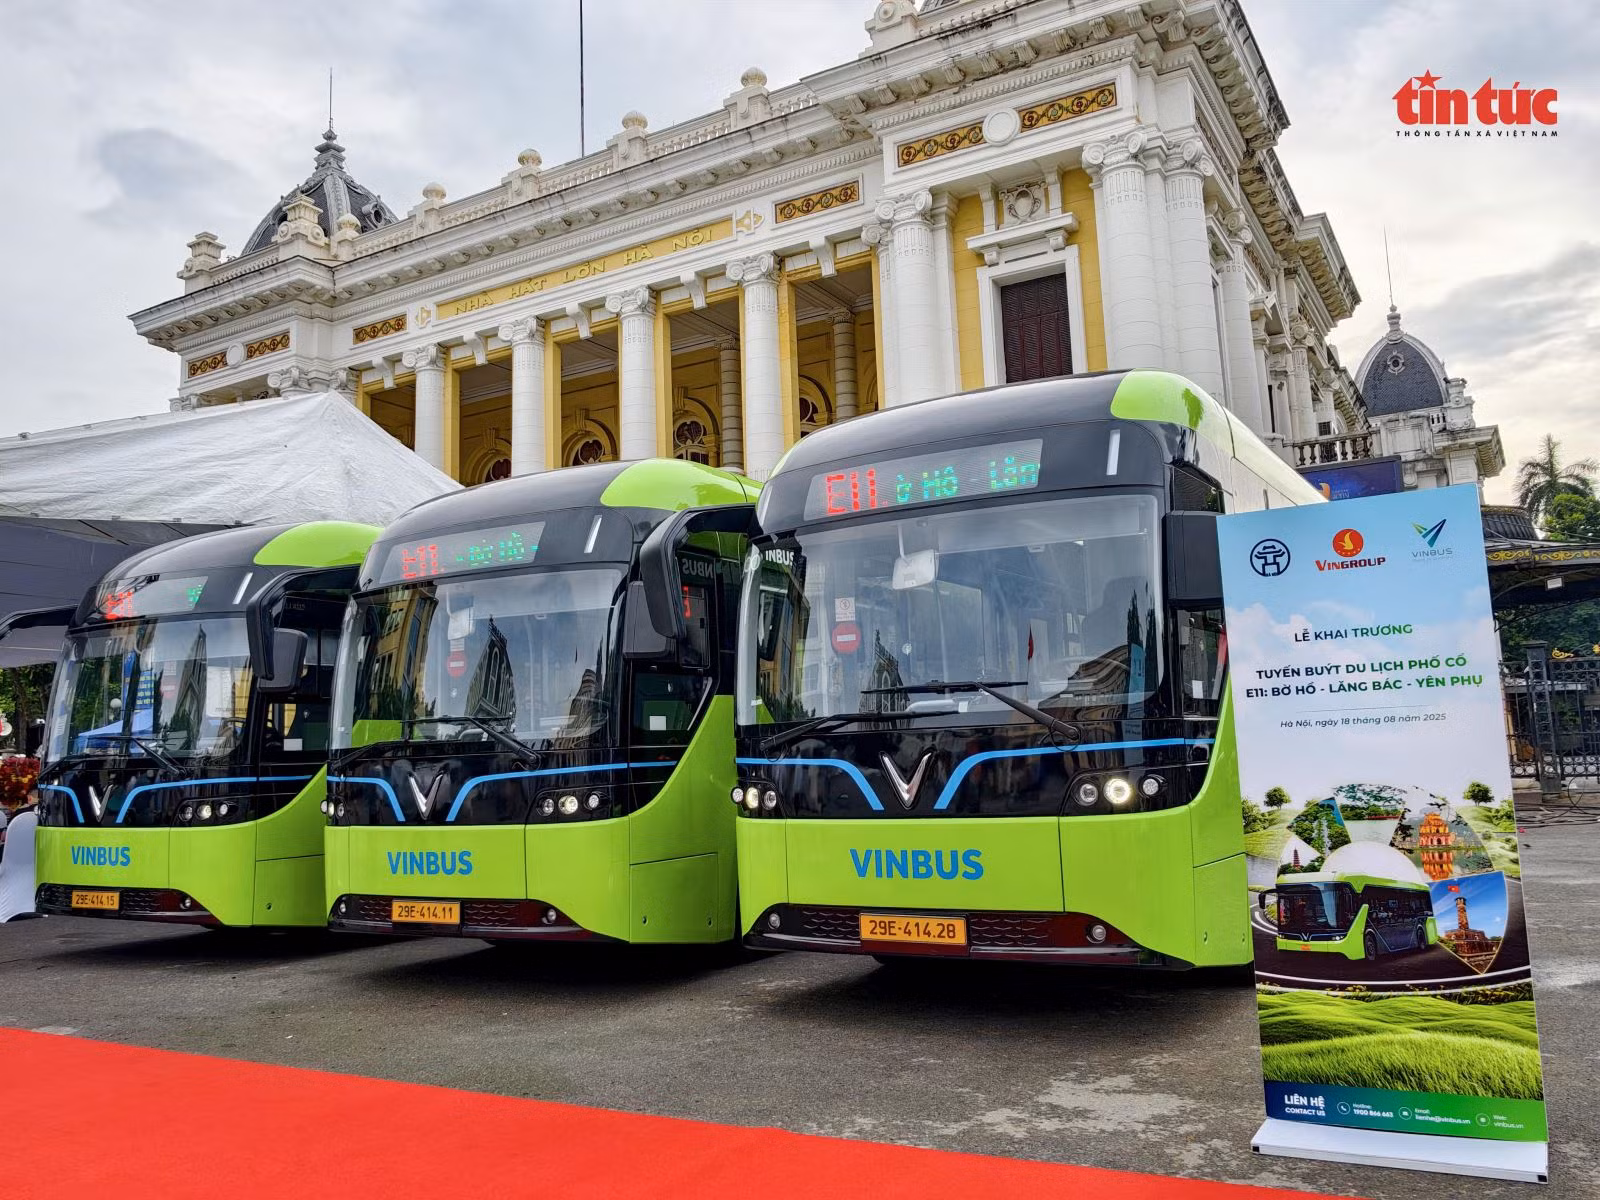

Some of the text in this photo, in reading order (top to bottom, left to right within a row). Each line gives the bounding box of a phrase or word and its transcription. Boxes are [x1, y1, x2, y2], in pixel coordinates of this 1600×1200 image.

[623, 243, 653, 266] HÀ
[672, 228, 712, 251] NỘI
[765, 549, 795, 567] INBUS
[1411, 547, 1453, 558] VINBUS
[1315, 556, 1386, 572] VINGROUP
[1295, 624, 1413, 643] LỄ KHAI TRƯƠNG
[1256, 664, 1300, 680] TUYẾN
[1305, 663, 1341, 677] BUÝT
[1346, 663, 1366, 674] DU
[1371, 660, 1403, 675] LỊCH
[1408, 654, 1441, 670] PHỐ
[1246, 688, 1267, 698] E11:
[1271, 684, 1292, 697] BỜ
[1329, 680, 1368, 693] LĂNG
[1372, 678, 1402, 691] BÁC
[1416, 675, 1446, 688] YÊN
[1451, 674, 1483, 688] PHỤ
[1280, 720, 1293, 728] Hà
[1315, 717, 1338, 728] ngày
[1352, 716, 1381, 726] tháng
[1383, 715, 1395, 724] 08
[1398, 714, 1421, 723] năm
[1423, 712, 1446, 722] 2025
[71, 845, 131, 867] VINBUS
[387, 850, 473, 876] VINBUS
[850, 848, 984, 881] VINBUS
[868, 919, 957, 940] 29E-414.28
[1284, 1093, 1326, 1110] LIÊN HỆ
[1284, 1106, 1326, 1117] CONTACT US
